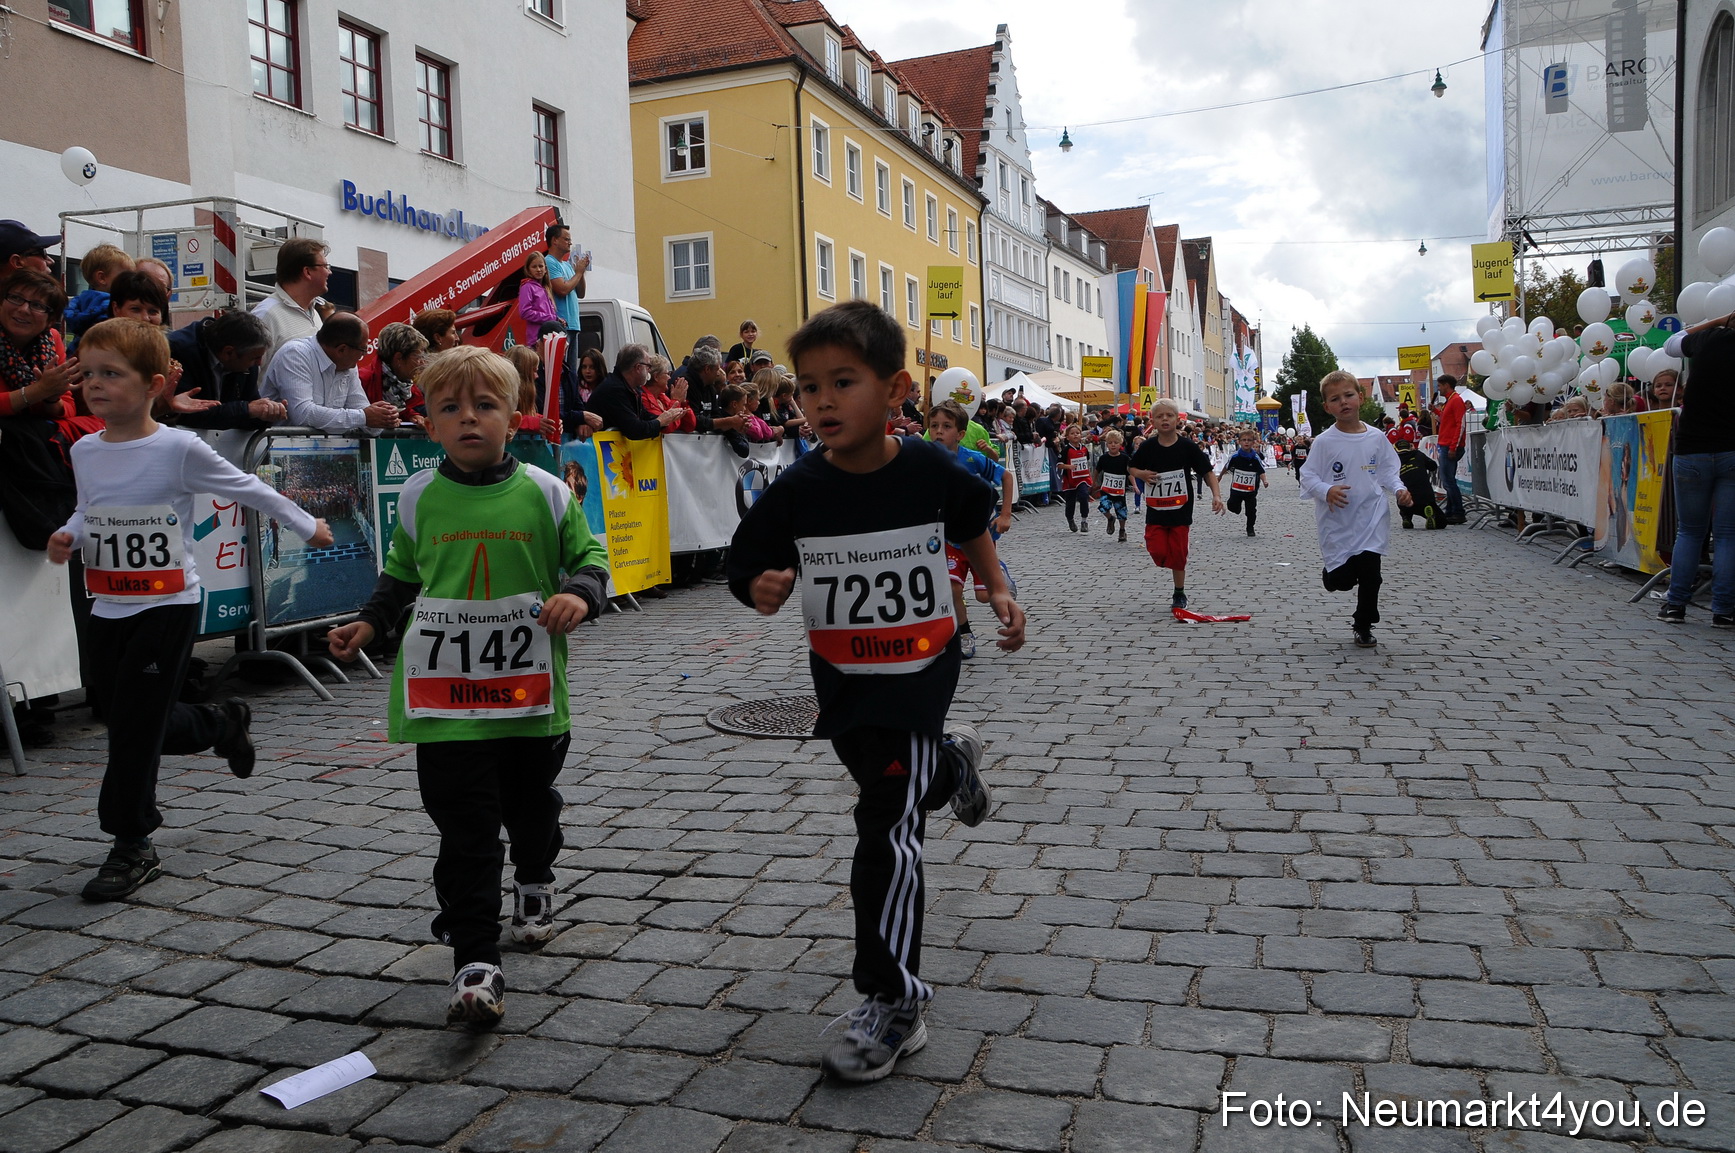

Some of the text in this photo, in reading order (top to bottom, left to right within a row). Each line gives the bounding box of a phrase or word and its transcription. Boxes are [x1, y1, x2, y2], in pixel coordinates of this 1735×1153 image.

[1473, 257, 1512, 270] Jugend-
[423, 230, 541, 311] Miet- & Serviceline: 09181 6352
[1484, 269, 1502, 279] lauf
[928, 280, 962, 290] Jugend-
[937, 290, 953, 299] lauf
[1143, 393, 1153, 405] A
[1403, 391, 1414, 404] A
[412, 454, 446, 468] Event-
[1105, 478, 1123, 488] 7139
[1236, 475, 1253, 485] 7137
[1150, 480, 1182, 497] 7174
[84, 514, 163, 527] PARTL Neumarkt
[609, 510, 626, 518] Pflaster
[610, 521, 643, 531] Außenplatten
[432, 529, 533, 545] 1. Goldhutlauf 2012
[612, 534, 634, 544] Palisaden
[89, 531, 171, 569] 7183
[613, 547, 629, 556] Stufen
[803, 543, 922, 566] PARTL Neumarkt
[107, 575, 151, 592] Lukas
[813, 565, 936, 626] 7239
[416, 608, 525, 624] PARTL Neumarkt
[419, 624, 534, 673] 7142
[851, 635, 915, 658] Oliver
[450, 683, 513, 704] Niklas
